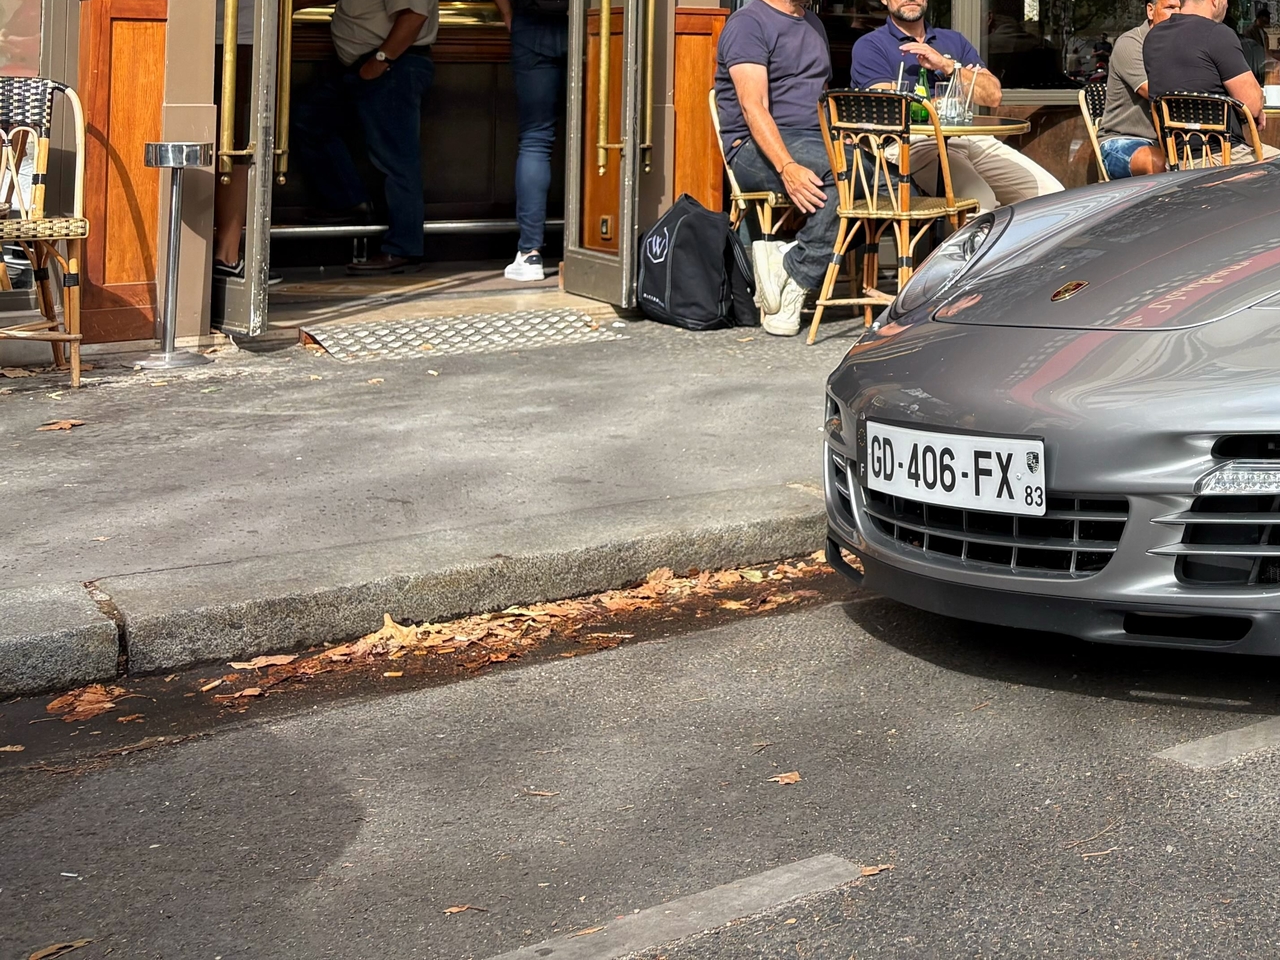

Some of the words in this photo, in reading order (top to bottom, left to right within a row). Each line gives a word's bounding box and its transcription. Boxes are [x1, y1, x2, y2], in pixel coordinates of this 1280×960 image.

[860, 462, 866, 477] F
[871, 434, 1015, 500] GD-406-FX
[1024, 485, 1044, 508] 83
